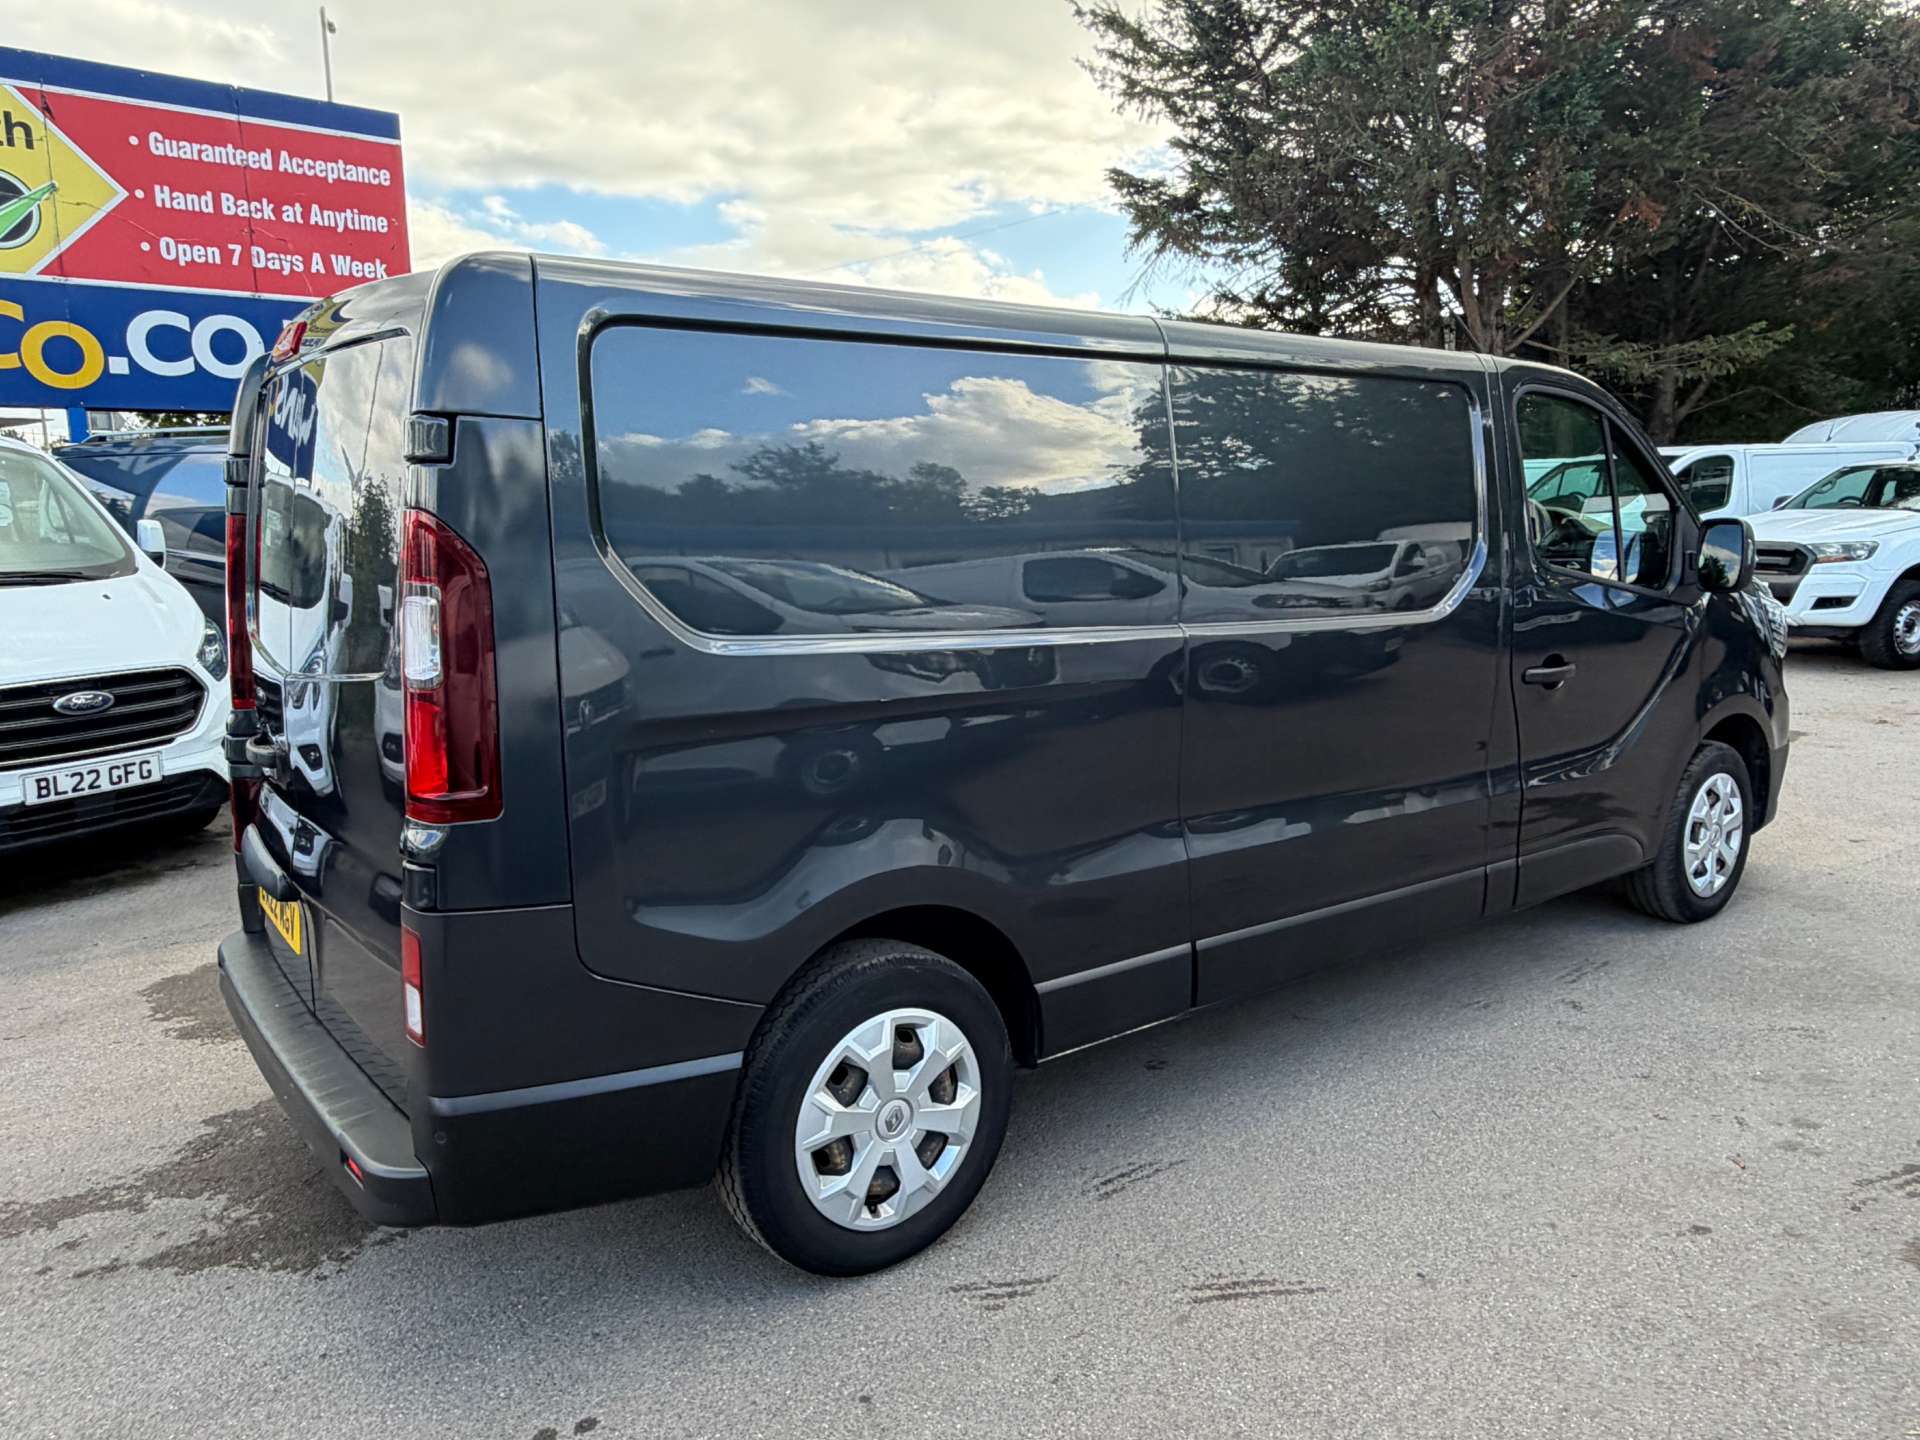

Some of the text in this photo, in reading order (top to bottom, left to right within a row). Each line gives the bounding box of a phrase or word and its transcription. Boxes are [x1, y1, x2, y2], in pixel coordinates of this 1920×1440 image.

[148, 131, 391, 187] Guaranteed Acceptance
[153, 184, 389, 234] Hand Back at Anytime
[159, 236, 388, 280] Open 7 Days A Week
[68, 694, 104, 711] Ford
[34, 760, 153, 800] BL22 GFG
